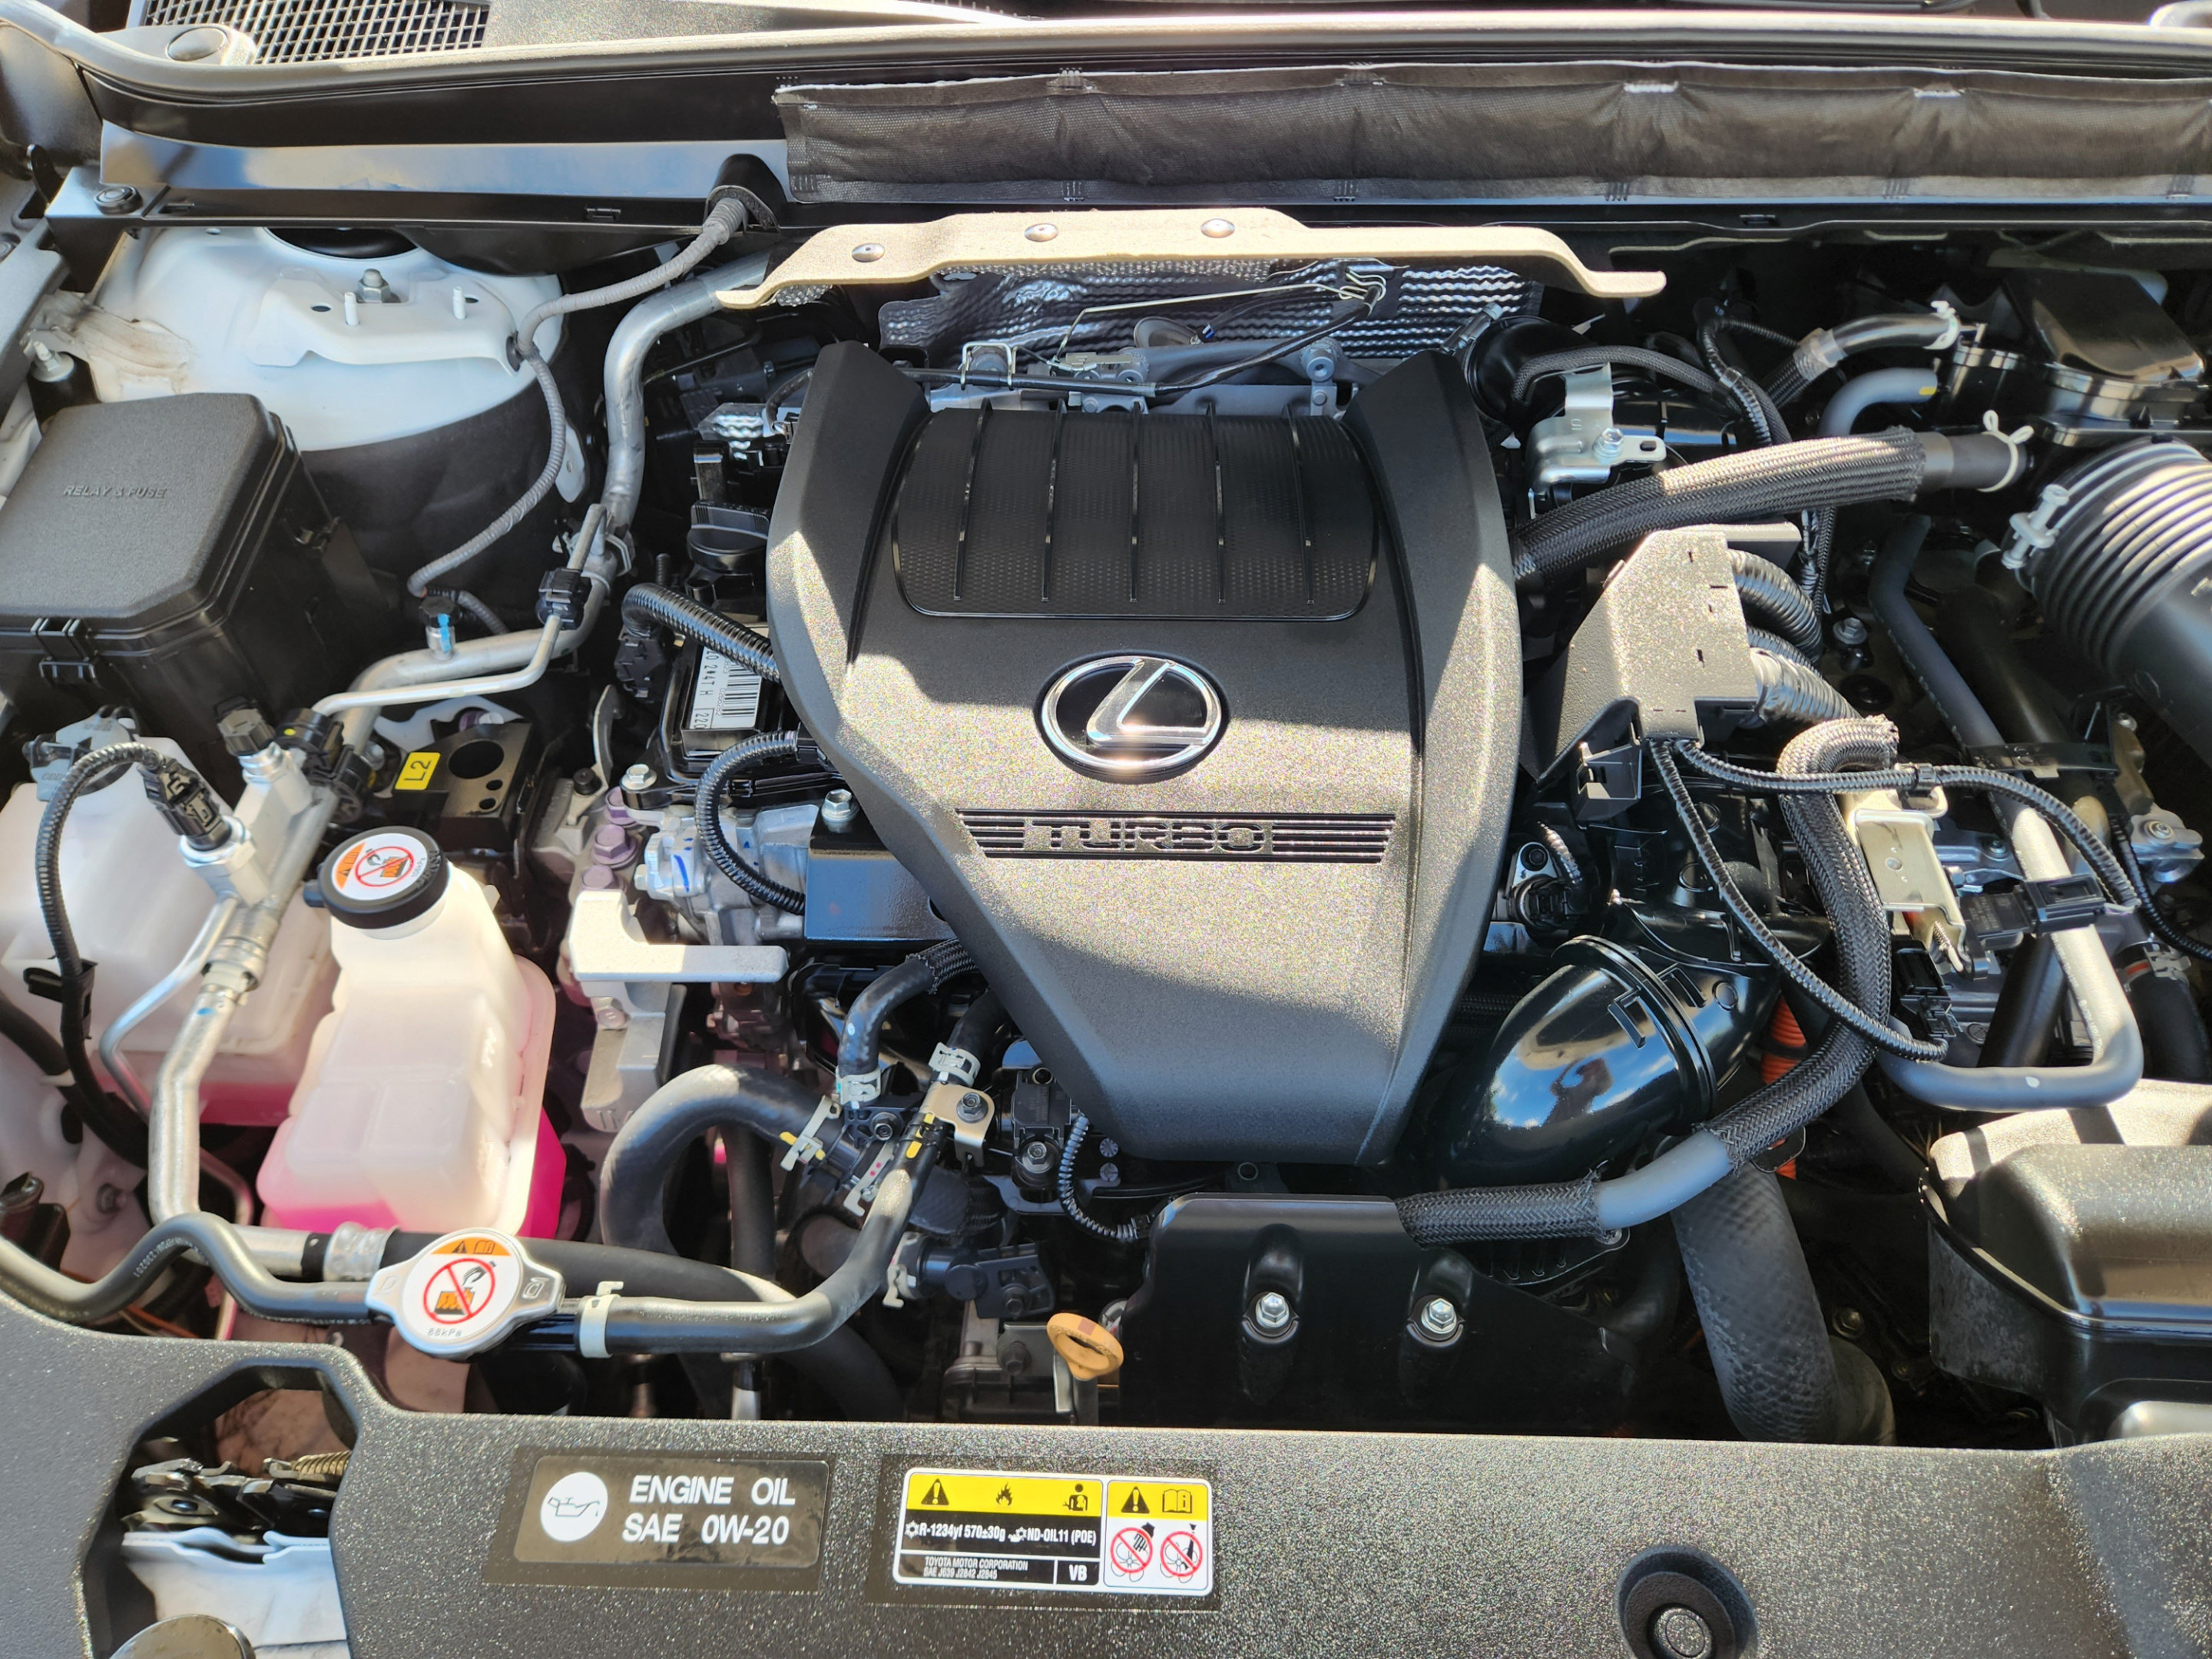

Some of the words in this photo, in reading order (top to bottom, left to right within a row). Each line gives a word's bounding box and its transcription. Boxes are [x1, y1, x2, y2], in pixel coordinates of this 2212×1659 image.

[63, 485, 112, 498] RELAY
[115, 486, 124, 498] &
[128, 487, 167, 499] FUSE
[404, 760, 431, 780] L2
[1028, 820, 1266, 853] TURBO
[426, 1326, 462, 1338] 88kPa
[629, 1475, 734, 1504] ENGINE
[751, 1477, 796, 1505] OIL
[622, 1512, 683, 1543] SAE
[701, 1514, 789, 1545] 0W-20
[919, 1522, 963, 1540] R-1234yf
[964, 1524, 1006, 1542] 570±30g
[1027, 1528, 1068, 1543] ND-OIL11
[1071, 1529, 1097, 1546] (POE)
[925, 1556, 952, 1568] TOYOTA
[952, 1558, 978, 1569] MOTOR
[979, 1559, 1028, 1571] CORPORATION
[923, 1568, 936, 1578] SAE
[938, 1568, 955, 1578] J639
[955, 1568, 976, 1579] J2842
[1068, 1565, 1088, 1581] VB
